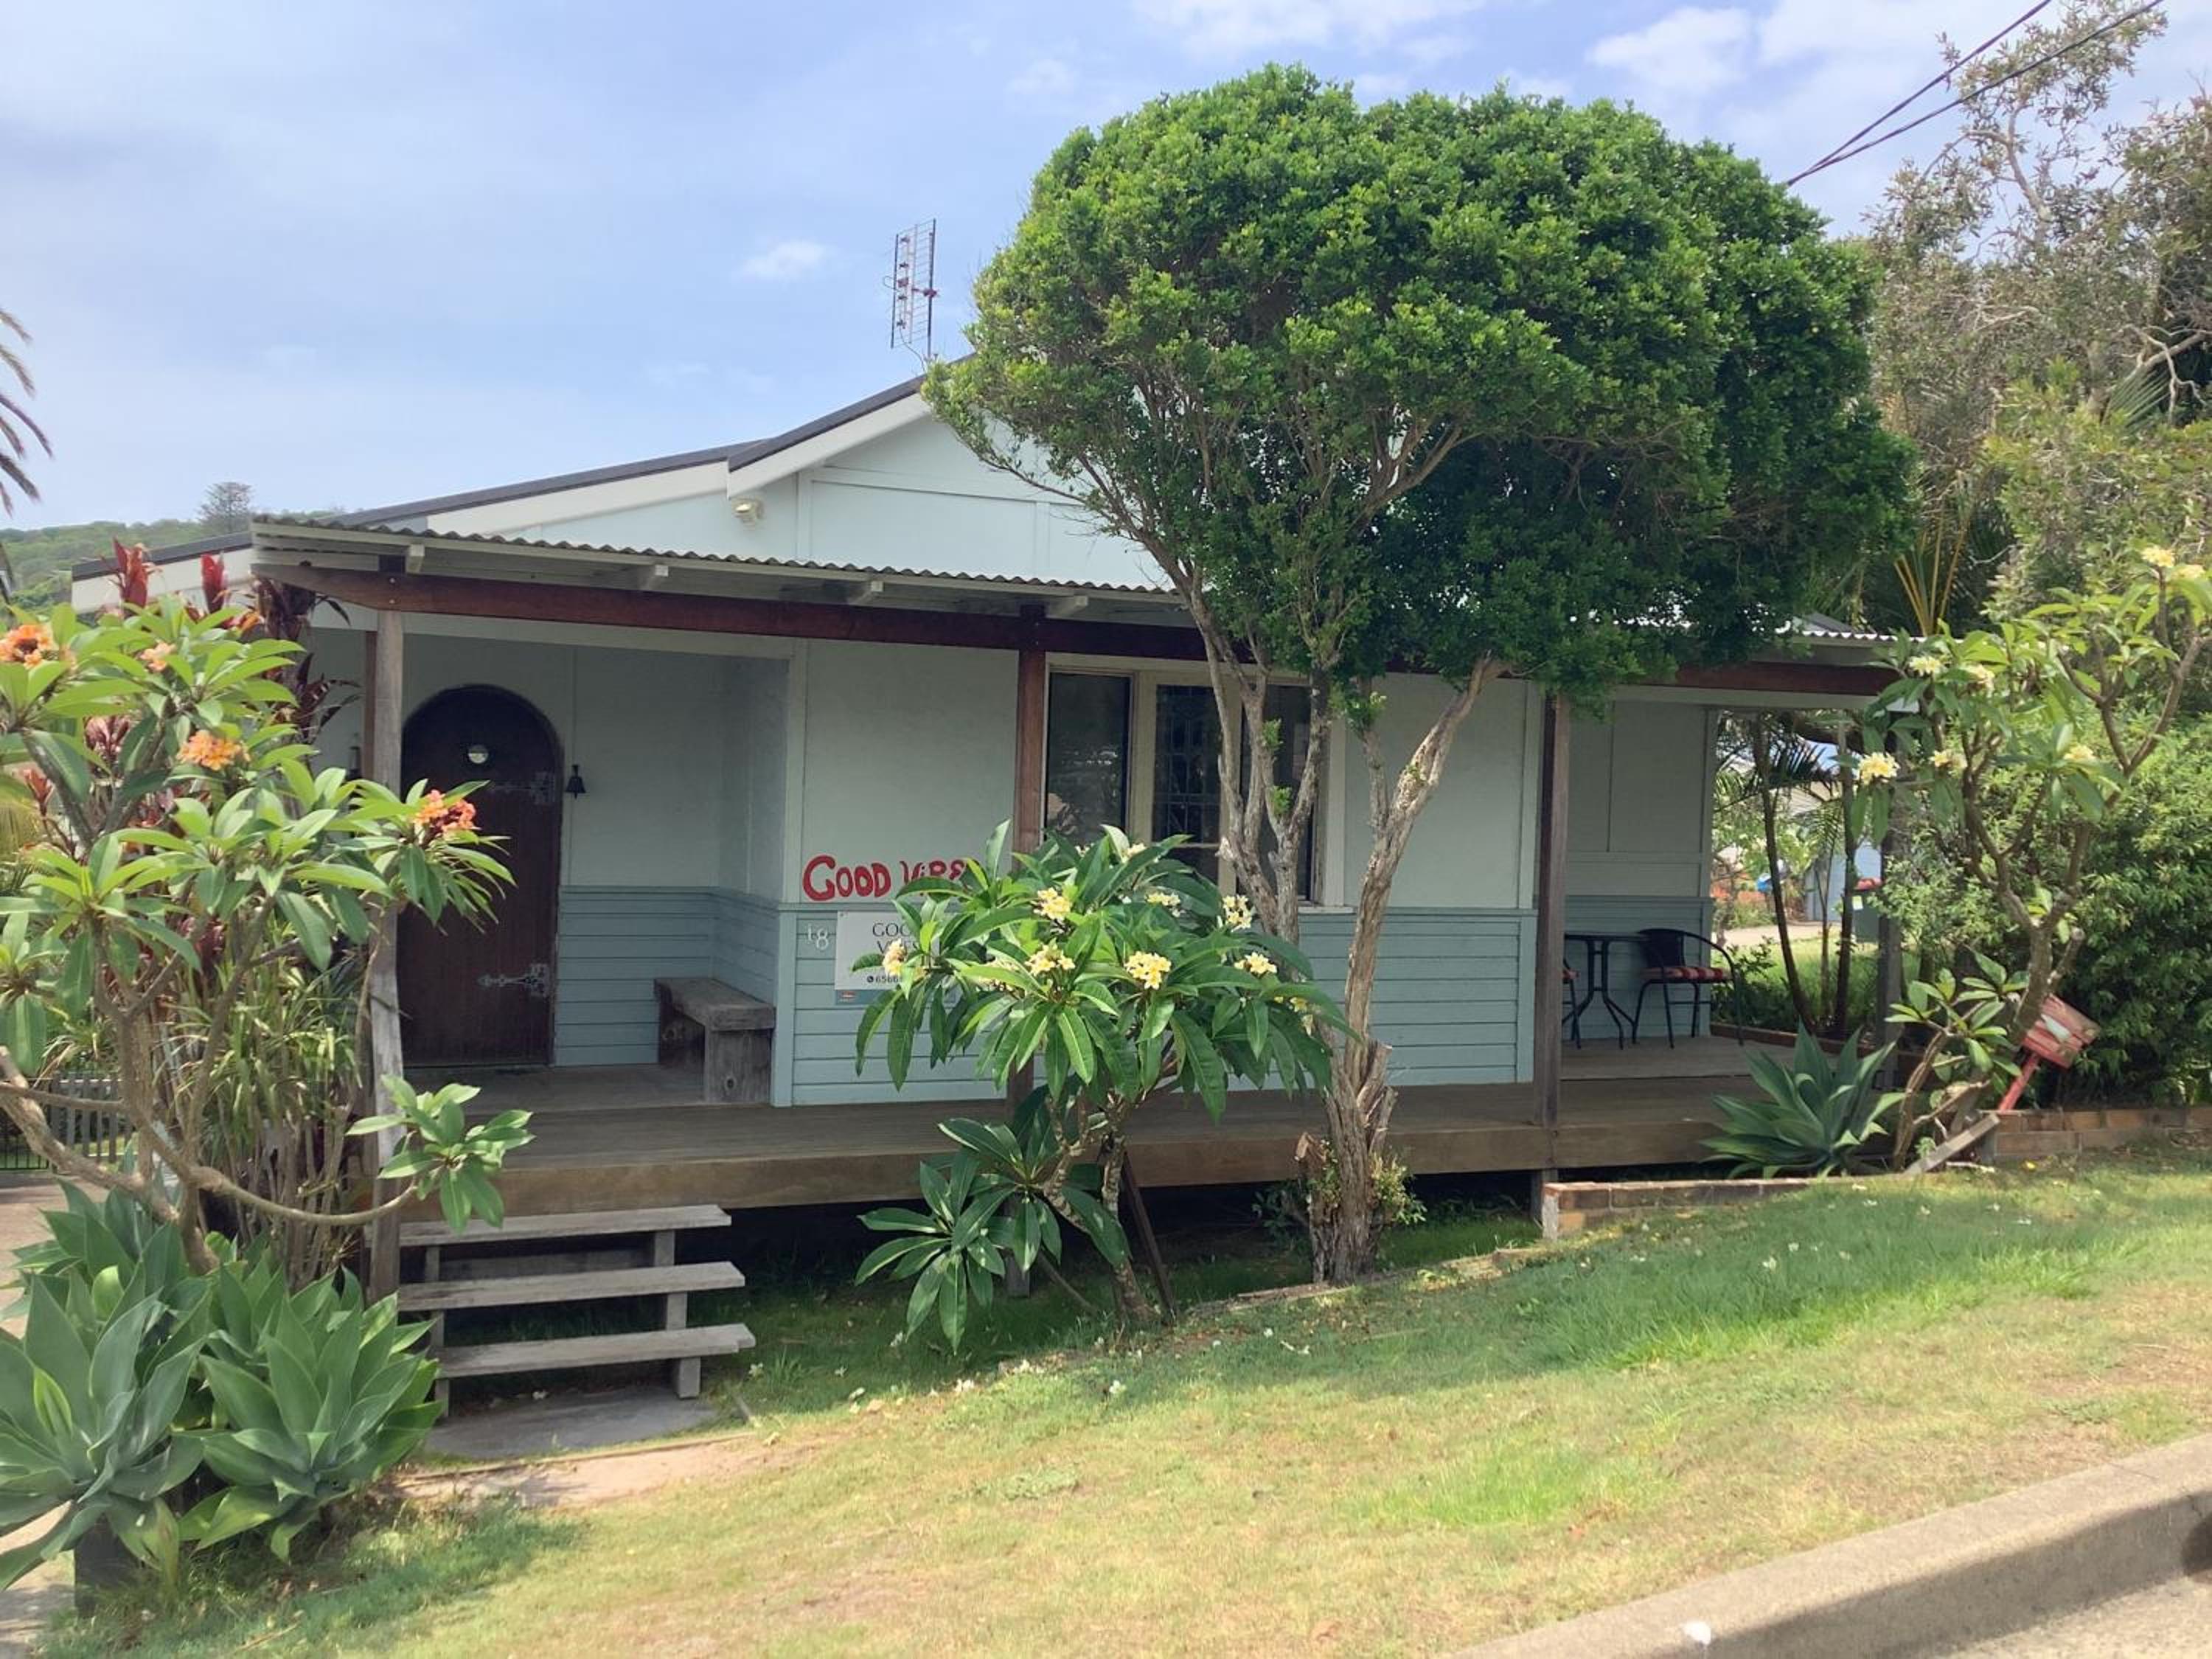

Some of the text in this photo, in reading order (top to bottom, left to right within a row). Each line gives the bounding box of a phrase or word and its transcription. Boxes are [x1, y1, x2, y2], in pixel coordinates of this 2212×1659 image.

[802, 855, 891, 901] GOOD
[807, 923, 829, 950] 18
[872, 922, 914, 937] GOO
